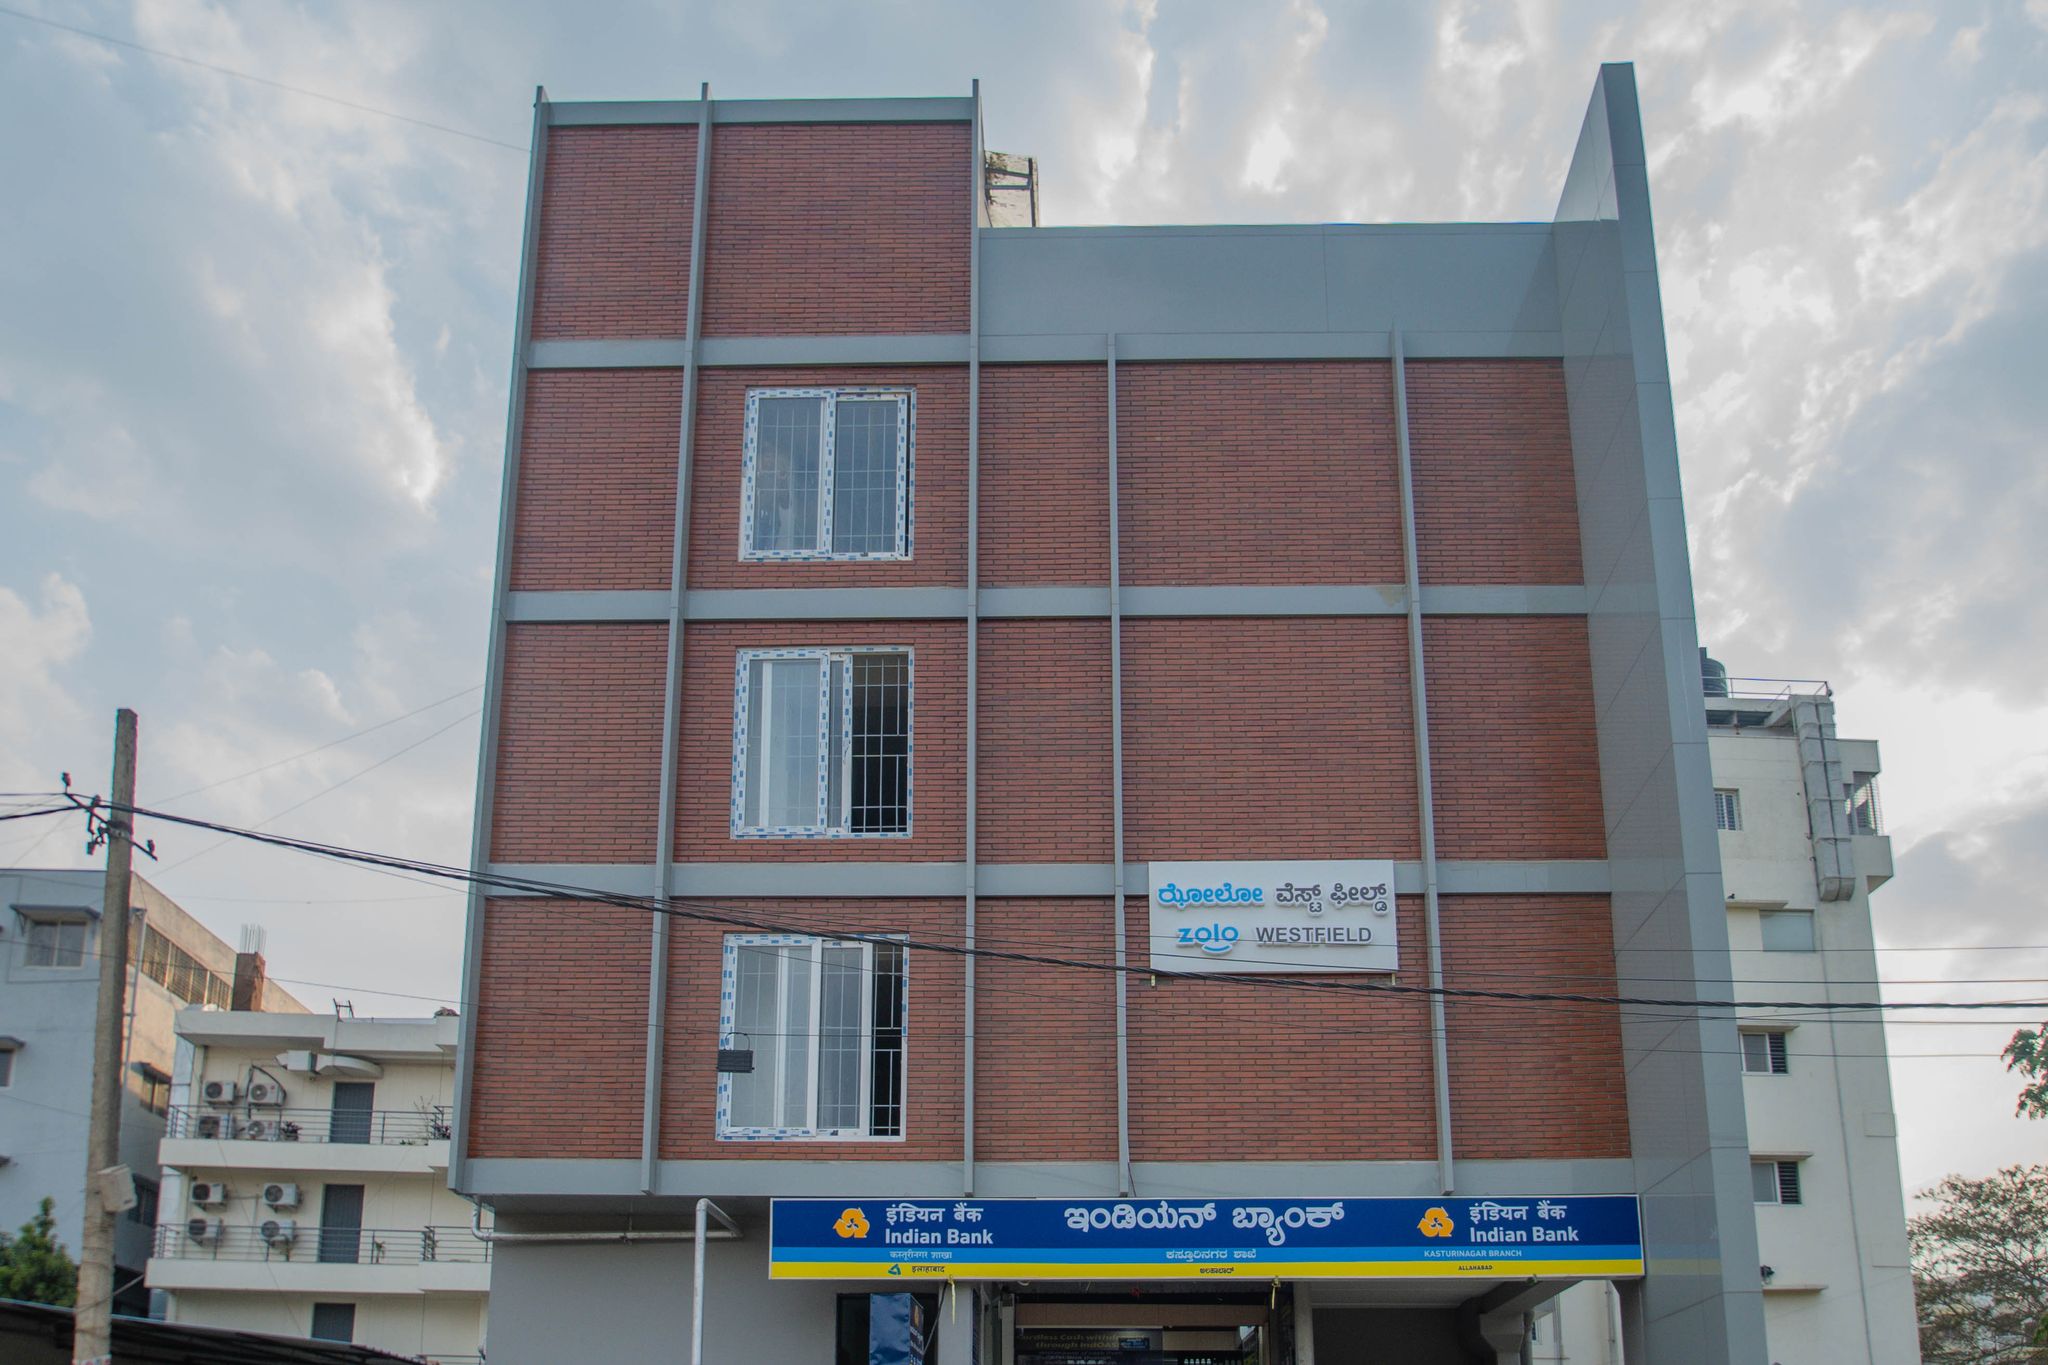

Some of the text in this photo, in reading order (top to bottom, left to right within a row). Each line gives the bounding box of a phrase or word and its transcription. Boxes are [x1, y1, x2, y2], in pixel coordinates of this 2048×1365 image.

[1275, 882, 1322, 913] ವೆಸ್ಟ್
[1177, 923, 1372, 943] zolo WESTFIELD
[885, 1202, 984, 1225] इंडियन बैंक
[1469, 1200, 1567, 1224] इंडियन बैंक
[1232, 1202, 1345, 1246] ಬ್ಯಾಂಕ್
[885, 1228, 994, 1244] Indian Bank
[1470, 1226, 1579, 1243] Indian Bank
[931, 1251, 953, 1260] शाखा
[1424, 1249, 1522, 1258] KASTURINAGAR BRANCH
[911, 1265, 945, 1274] इलाहाबाद
